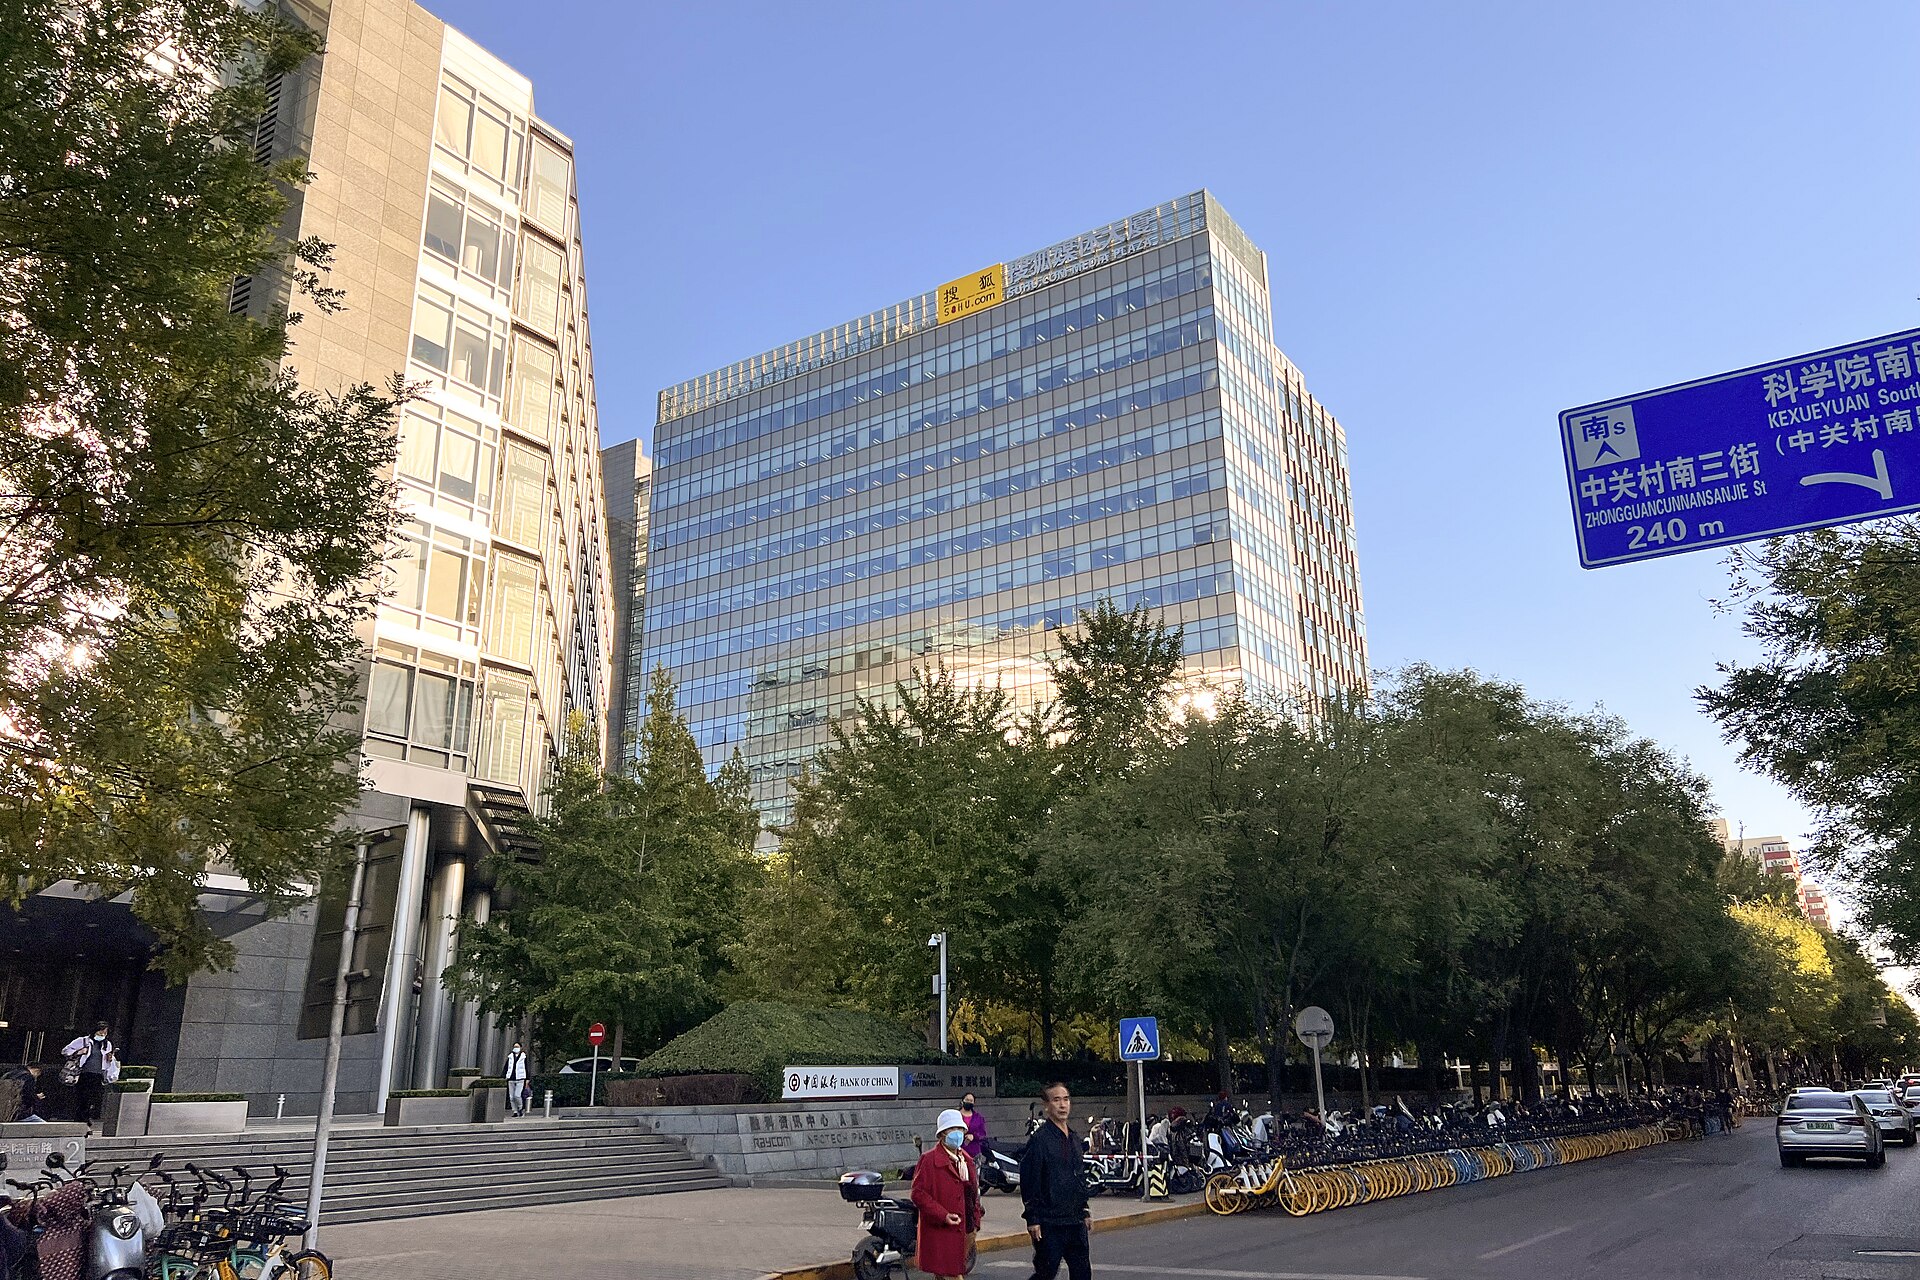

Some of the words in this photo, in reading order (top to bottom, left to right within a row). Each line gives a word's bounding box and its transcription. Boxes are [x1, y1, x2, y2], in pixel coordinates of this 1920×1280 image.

[1071, 255, 1110, 274] MEDIA
[1113, 236, 1159, 260] PLAZA
[944, 272, 995, 304] 搜狐
[944, 292, 995, 317] SOHU.com
[1762, 340, 1920, 407] 科学院南
[1768, 393, 1870, 429] KEXUEYUAN
[1580, 416, 1610, 443] 南
[1613, 421, 1626, 435] S
[1775, 405, 1920, 456] (中关村南
[1580, 442, 1761, 507] 中关村南三街
[1585, 483, 1749, 528] ZHONGGUANCUNNANSANJIE
[1754, 480, 1767, 496] St
[1626, 518, 1687, 550] 240
[1698, 520, 1725, 537] m
[803, 1074, 838, 1090] 中国银行
[841, 1078, 860, 1087] BANK
[861, 1078, 871, 1087] OF
[871, 1077, 893, 1086] CHINA
[64, 1141, 80, 1164] 2
[804, 1132, 848, 1145] NFOTECH
[853, 1131, 873, 1142] PARK
[877, 1130, 906, 1141] TOWER
